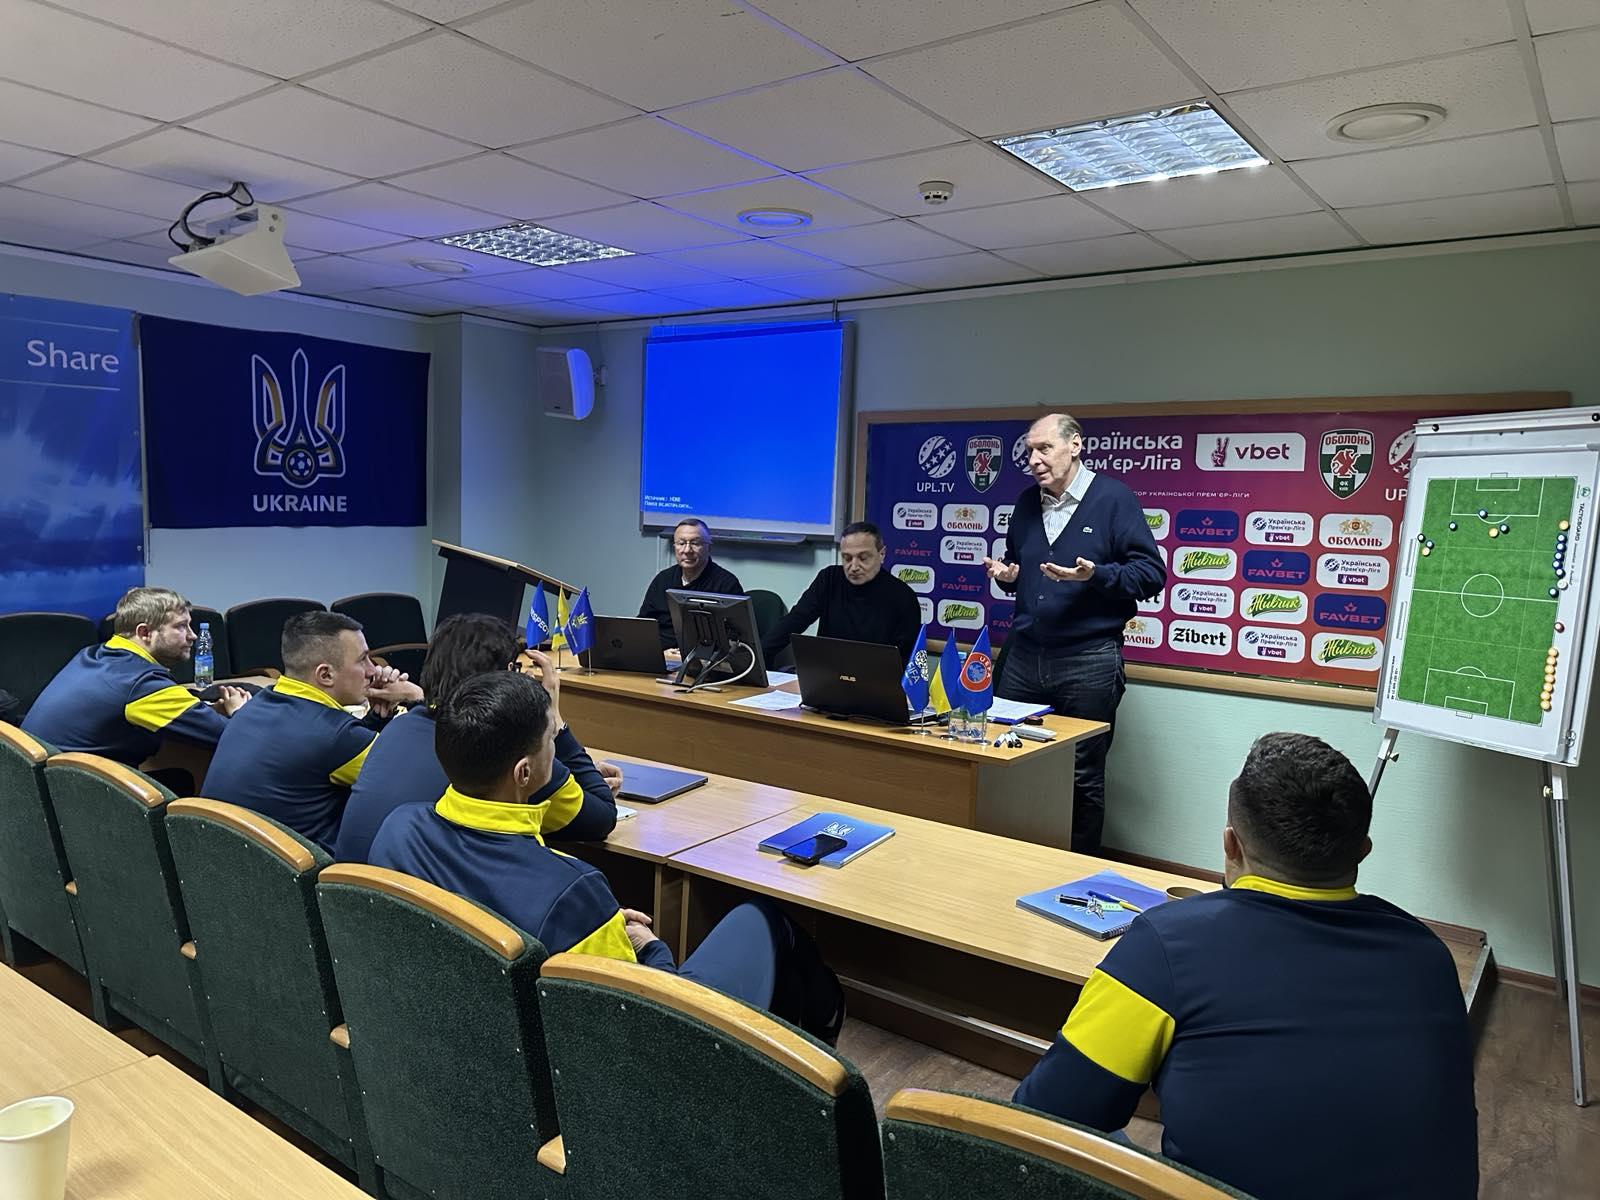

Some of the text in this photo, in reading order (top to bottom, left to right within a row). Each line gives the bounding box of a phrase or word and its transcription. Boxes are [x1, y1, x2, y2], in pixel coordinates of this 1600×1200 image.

[27, 339, 119, 373] Share
[1081, 431, 1183, 454] раїнська
[1325, 435, 1370, 445] ОБОЛОНЬ
[1235, 443, 1290, 460] vbet
[1084, 454, 1181, 473] ем'єр-Ліга
[916, 482, 955, 493] UPL.TV
[1385, 488, 1408, 501] UP
[253, 494, 347, 512] UKRAINE
[947, 521, 983, 530] ОБОЛОНЬ
[1180, 527, 1234, 536] FAVBET
[1328, 536, 1383, 547] ОБОЛОНЬ
[1247, 568, 1306, 579] FAVBET
[992, 620, 1013, 628] FAV
[1319, 612, 1380, 624] FAVBET
[1124, 635, 1155, 645] ОЛОНЬ
[1172, 627, 1227, 647] Zibert
[906, 661, 921, 685] FIFA
